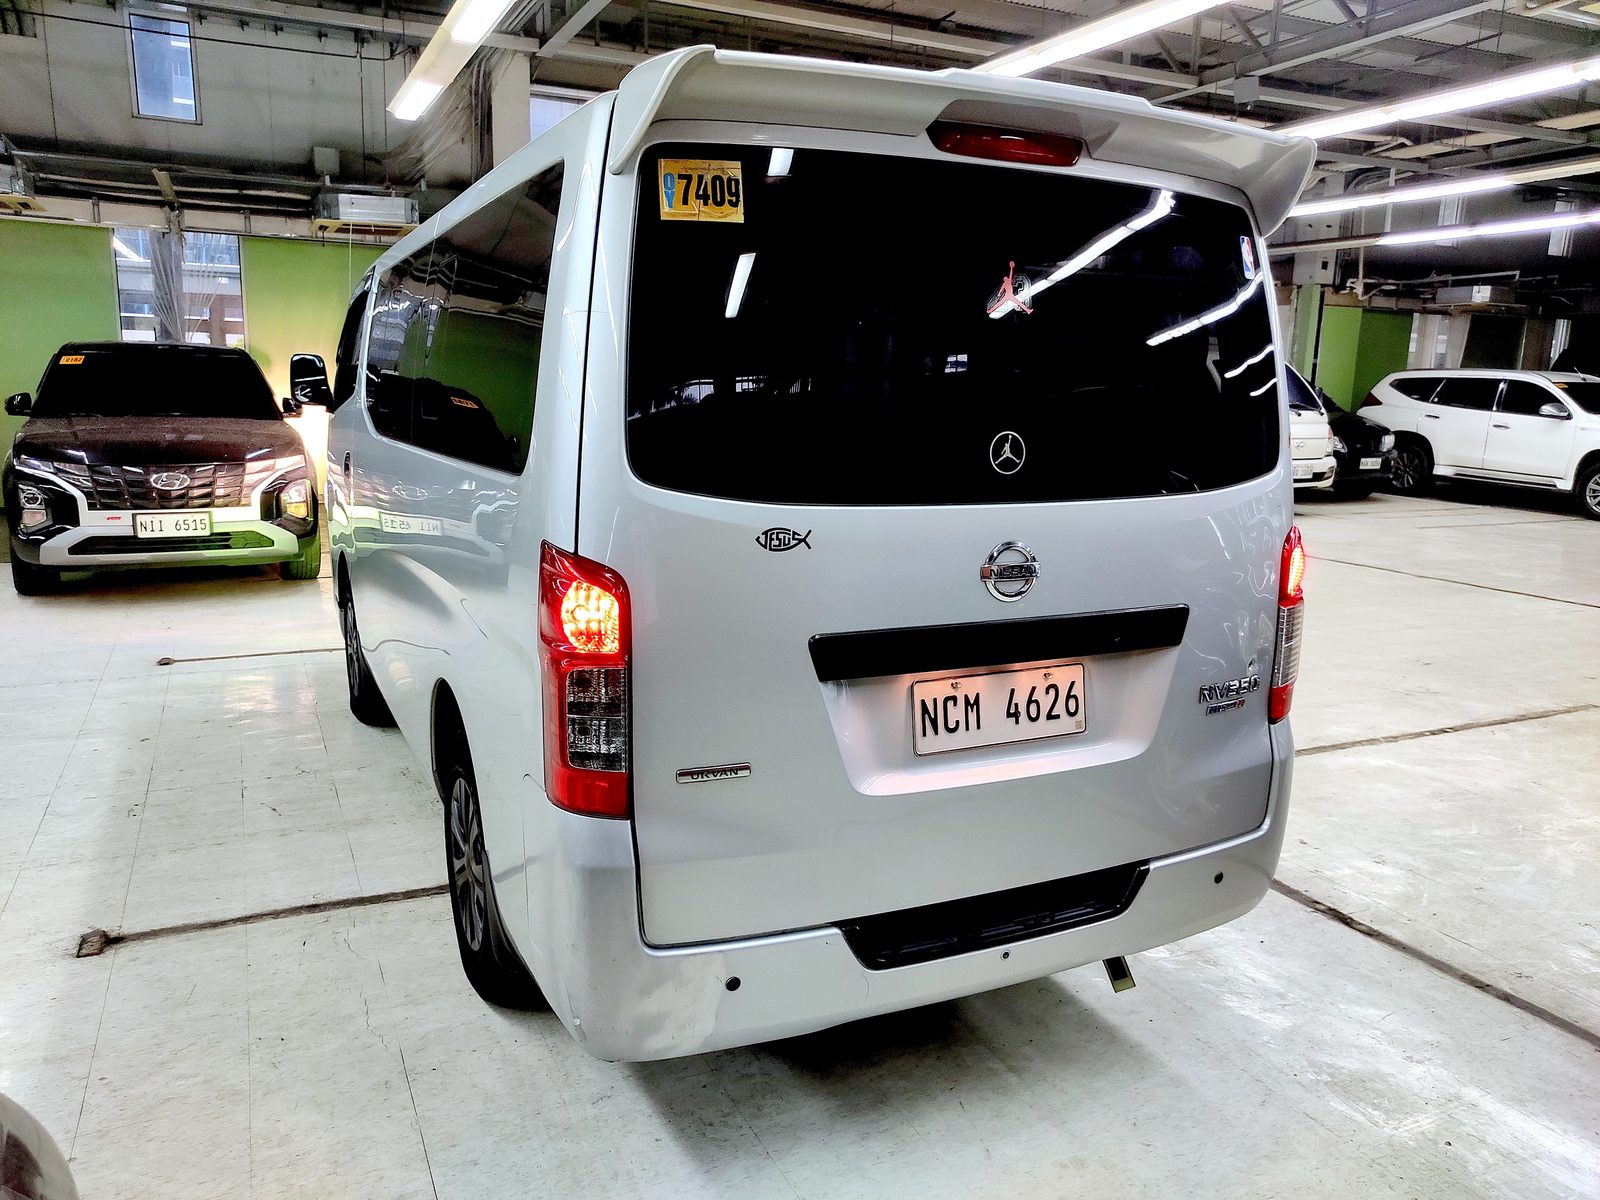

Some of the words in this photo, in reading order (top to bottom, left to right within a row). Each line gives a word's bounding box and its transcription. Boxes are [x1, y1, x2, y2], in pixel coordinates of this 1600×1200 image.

[677, 173, 740, 208] 7409
[139, 519, 164, 533] NII
[174, 518, 208, 532] 6515
[755, 527, 812, 552] JESUS
[989, 564, 1037, 578] NISSAN
[920, 691, 982, 738] NCM
[1005, 680, 1080, 725] 4626
